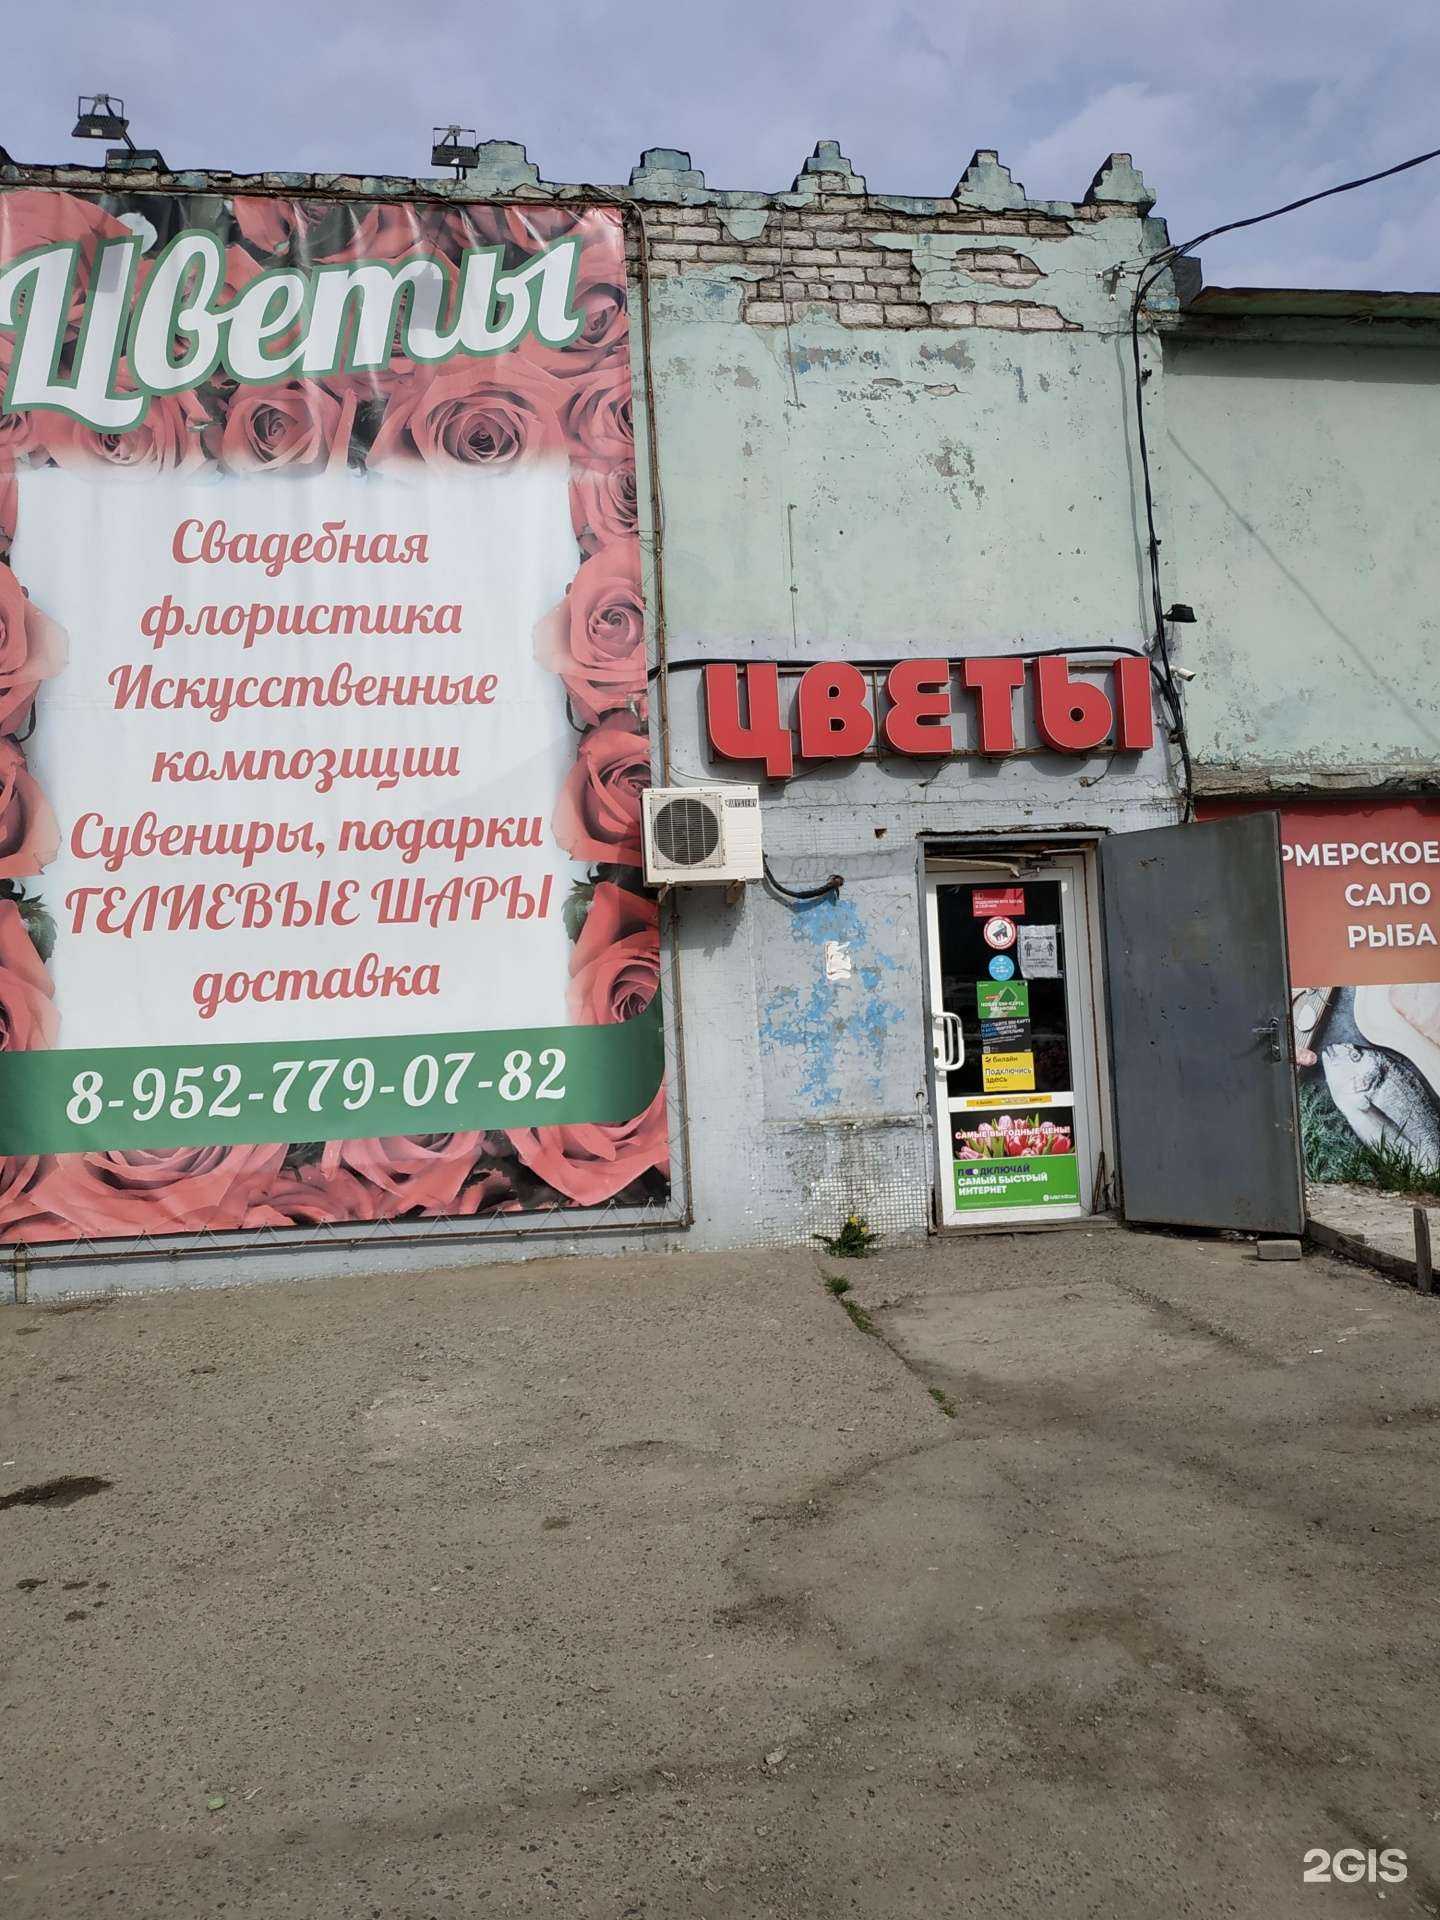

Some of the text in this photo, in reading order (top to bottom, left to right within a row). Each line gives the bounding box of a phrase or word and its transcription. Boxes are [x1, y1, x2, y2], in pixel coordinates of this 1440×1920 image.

[0, 233, 582, 429] Цветы
[172, 519, 430, 577] Свадебная
[140, 594, 463, 650] флористика
[107, 662, 499, 723] Искусственные
[703, 655, 1154, 779] ЦВЕТЫ
[151, 744, 461, 793] композиции
[70, 811, 544, 872] Сувениры, подарки
[1282, 841, 1440, 867] РМЕРСКОЕ
[64, 874, 553, 938] ГЕЛИЕВЫЕ ШАРЫ
[1344, 881, 1432, 907] САЛО
[1347, 923, 1438, 949] РЫБА
[192, 952, 442, 1019] доставка
[985, 1067, 1032, 1077] Подключись
[992, 1055, 1018, 1063] билайн
[64, 1047, 569, 1126] 8-952-779-07-82
[955, 1130, 987, 1140] САМЫЕ
[958, 1171, 1048, 1187] САМЫЙ БЫСТРЫЙ
[959, 1185, 1008, 1196] ИНТЕРНЕТ
